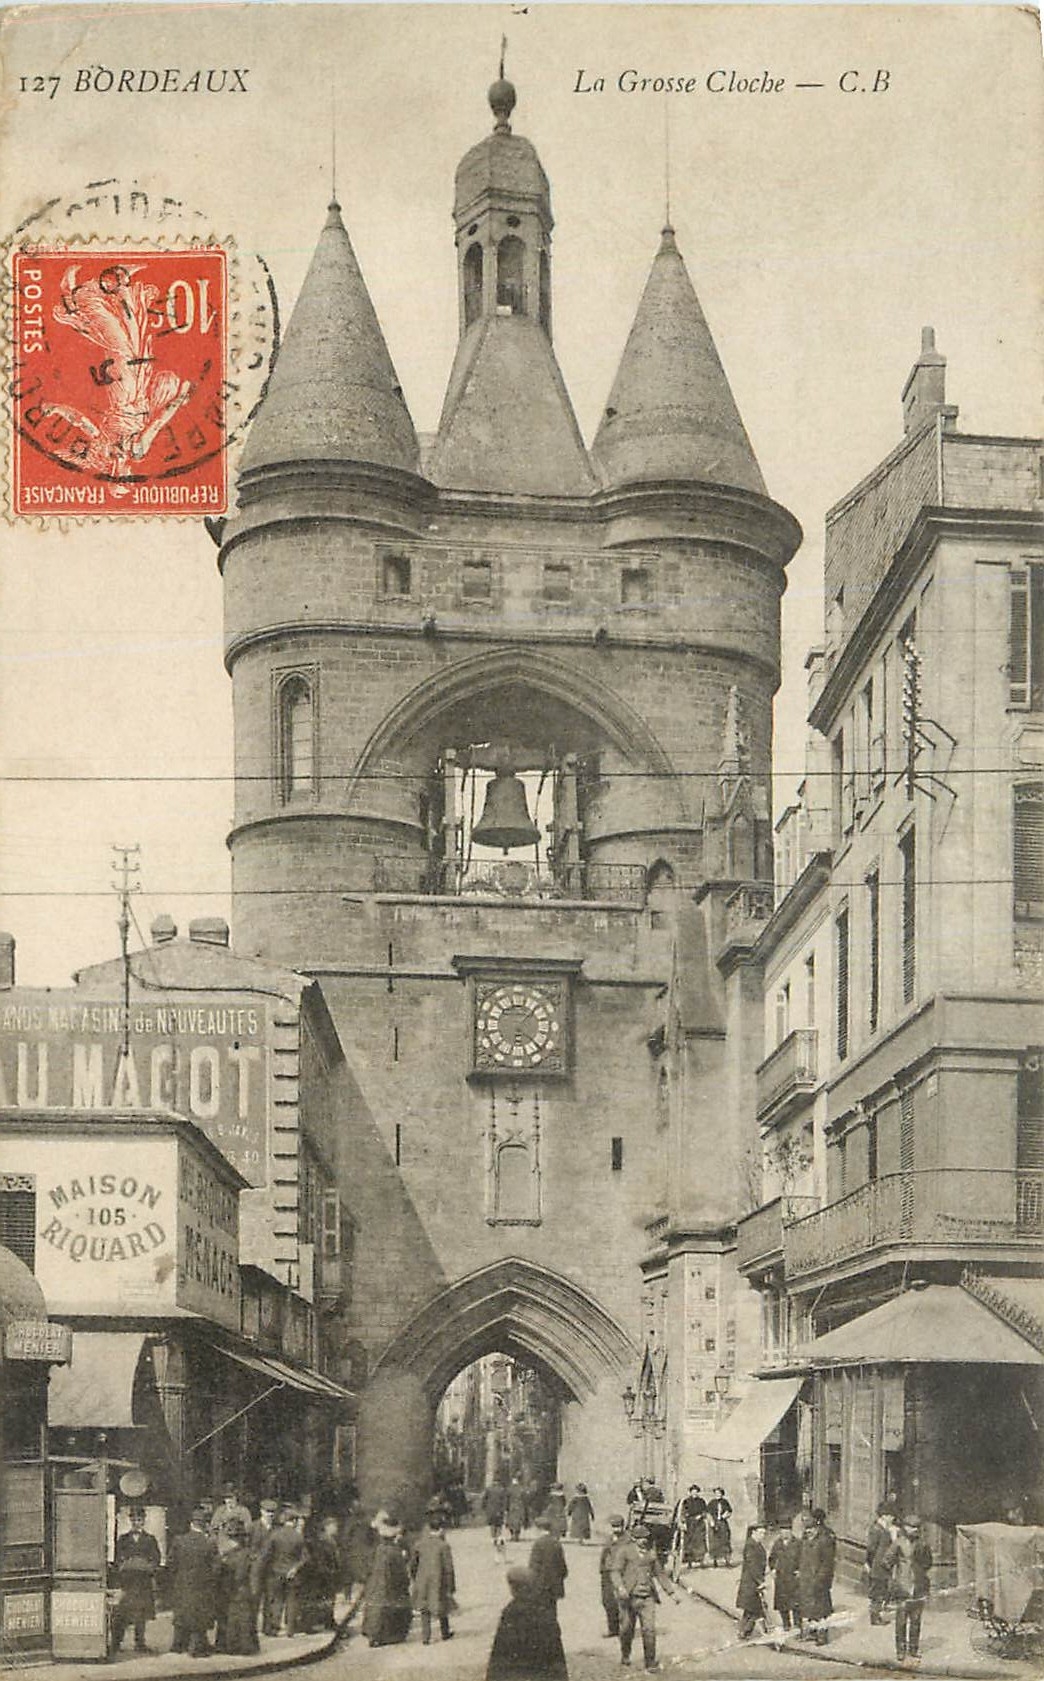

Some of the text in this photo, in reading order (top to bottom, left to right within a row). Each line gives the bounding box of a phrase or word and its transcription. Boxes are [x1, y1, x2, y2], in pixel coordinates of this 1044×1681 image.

[22, 268, 44, 354] POSTES
[23, 483, 106, 504] FRANÇAISE
[135, 1010, 152, 1033] de
[48, 1174, 162, 1210] MAISON
[87, 1207, 126, 1226] 105
[39, 1216, 167, 1263] RIQUARD
